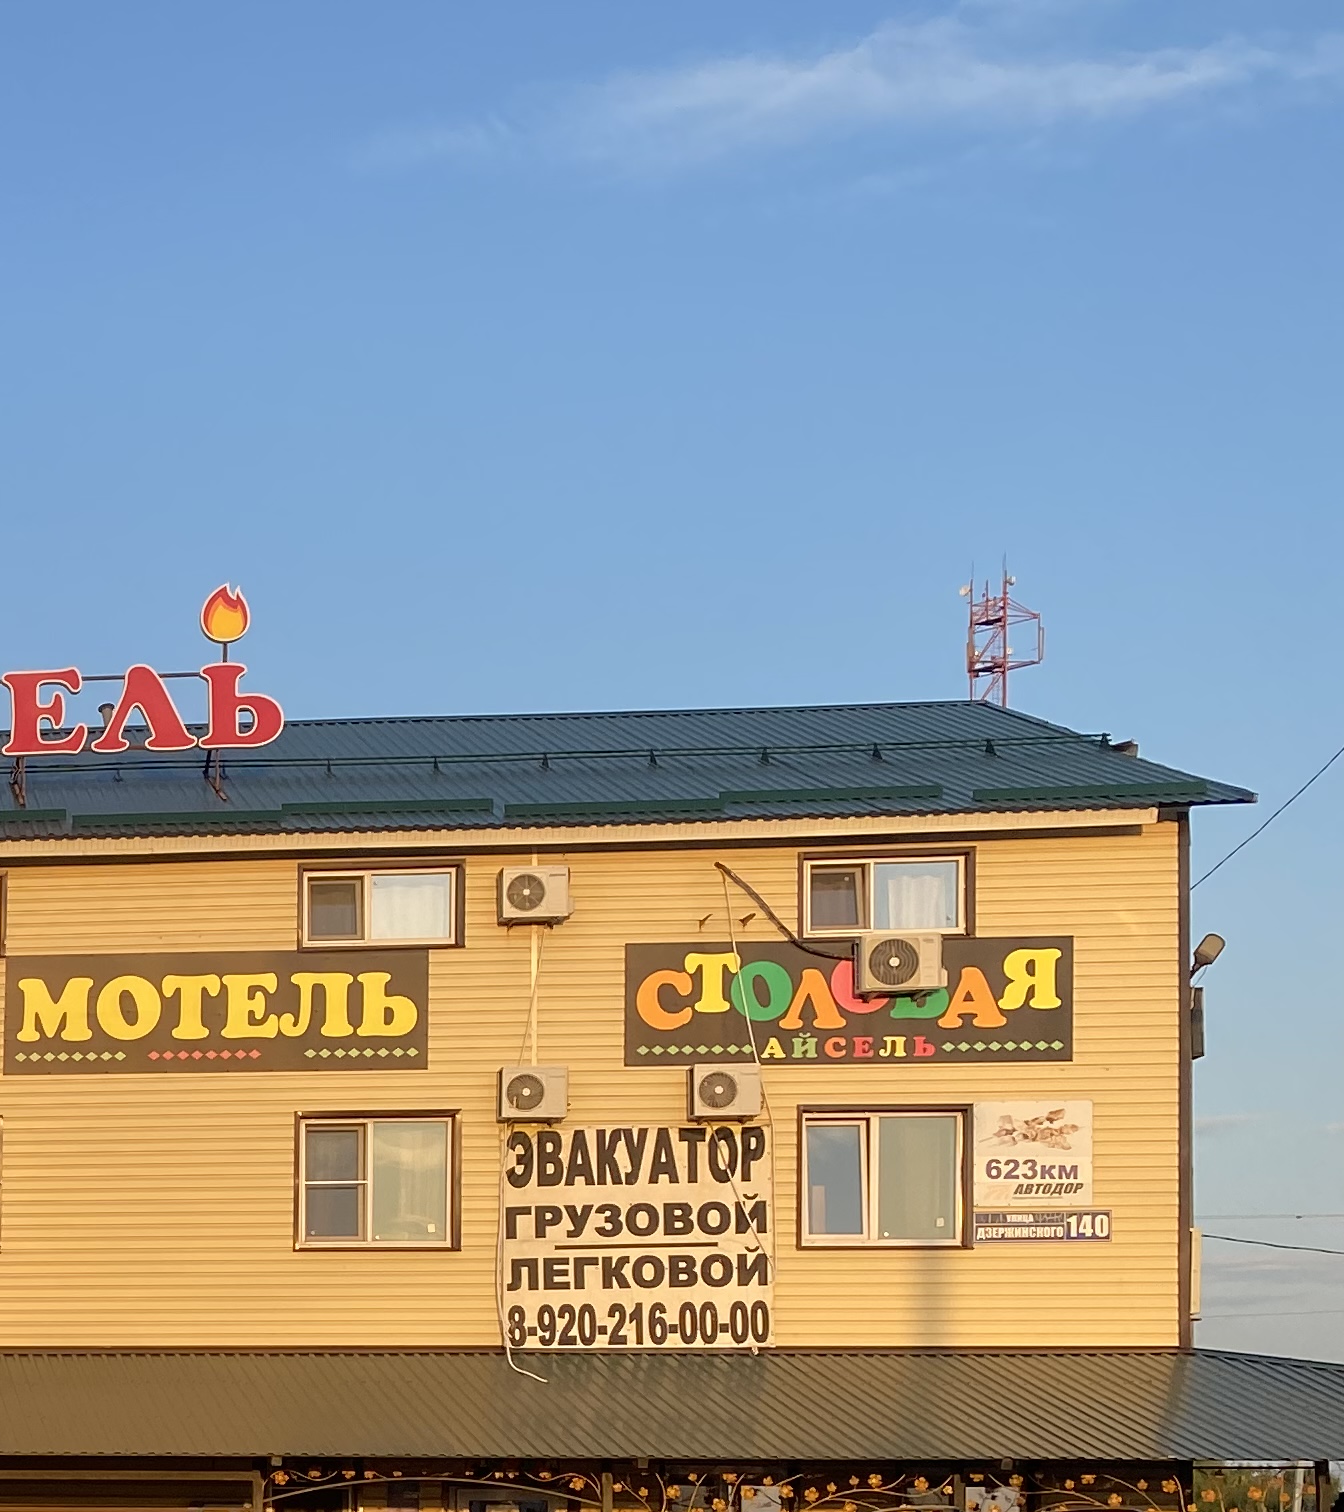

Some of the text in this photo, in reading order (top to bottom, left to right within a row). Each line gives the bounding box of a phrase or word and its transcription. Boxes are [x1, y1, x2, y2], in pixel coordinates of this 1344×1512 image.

[17, 971, 419, 1042] МОТЕЛЬ
[761, 1032, 937, 1060] АЙСЕЛЬ
[506, 1126, 767, 1188] ЭВАКУАТОР
[985, 1158, 1079, 1180] 623км
[1013, 1182, 1084, 1196] АВТОДОР
[504, 1194, 768, 1239] ГРУЗОВОЙ
[976, 1226, 1064, 1240] ДЗЕРЖИНСКОГО
[1067, 1214, 1109, 1237] 140
[507, 1244, 768, 1291] ЛЕГКОВОЙ
[508, 1301, 770, 1348] 8-920-216-00-00
